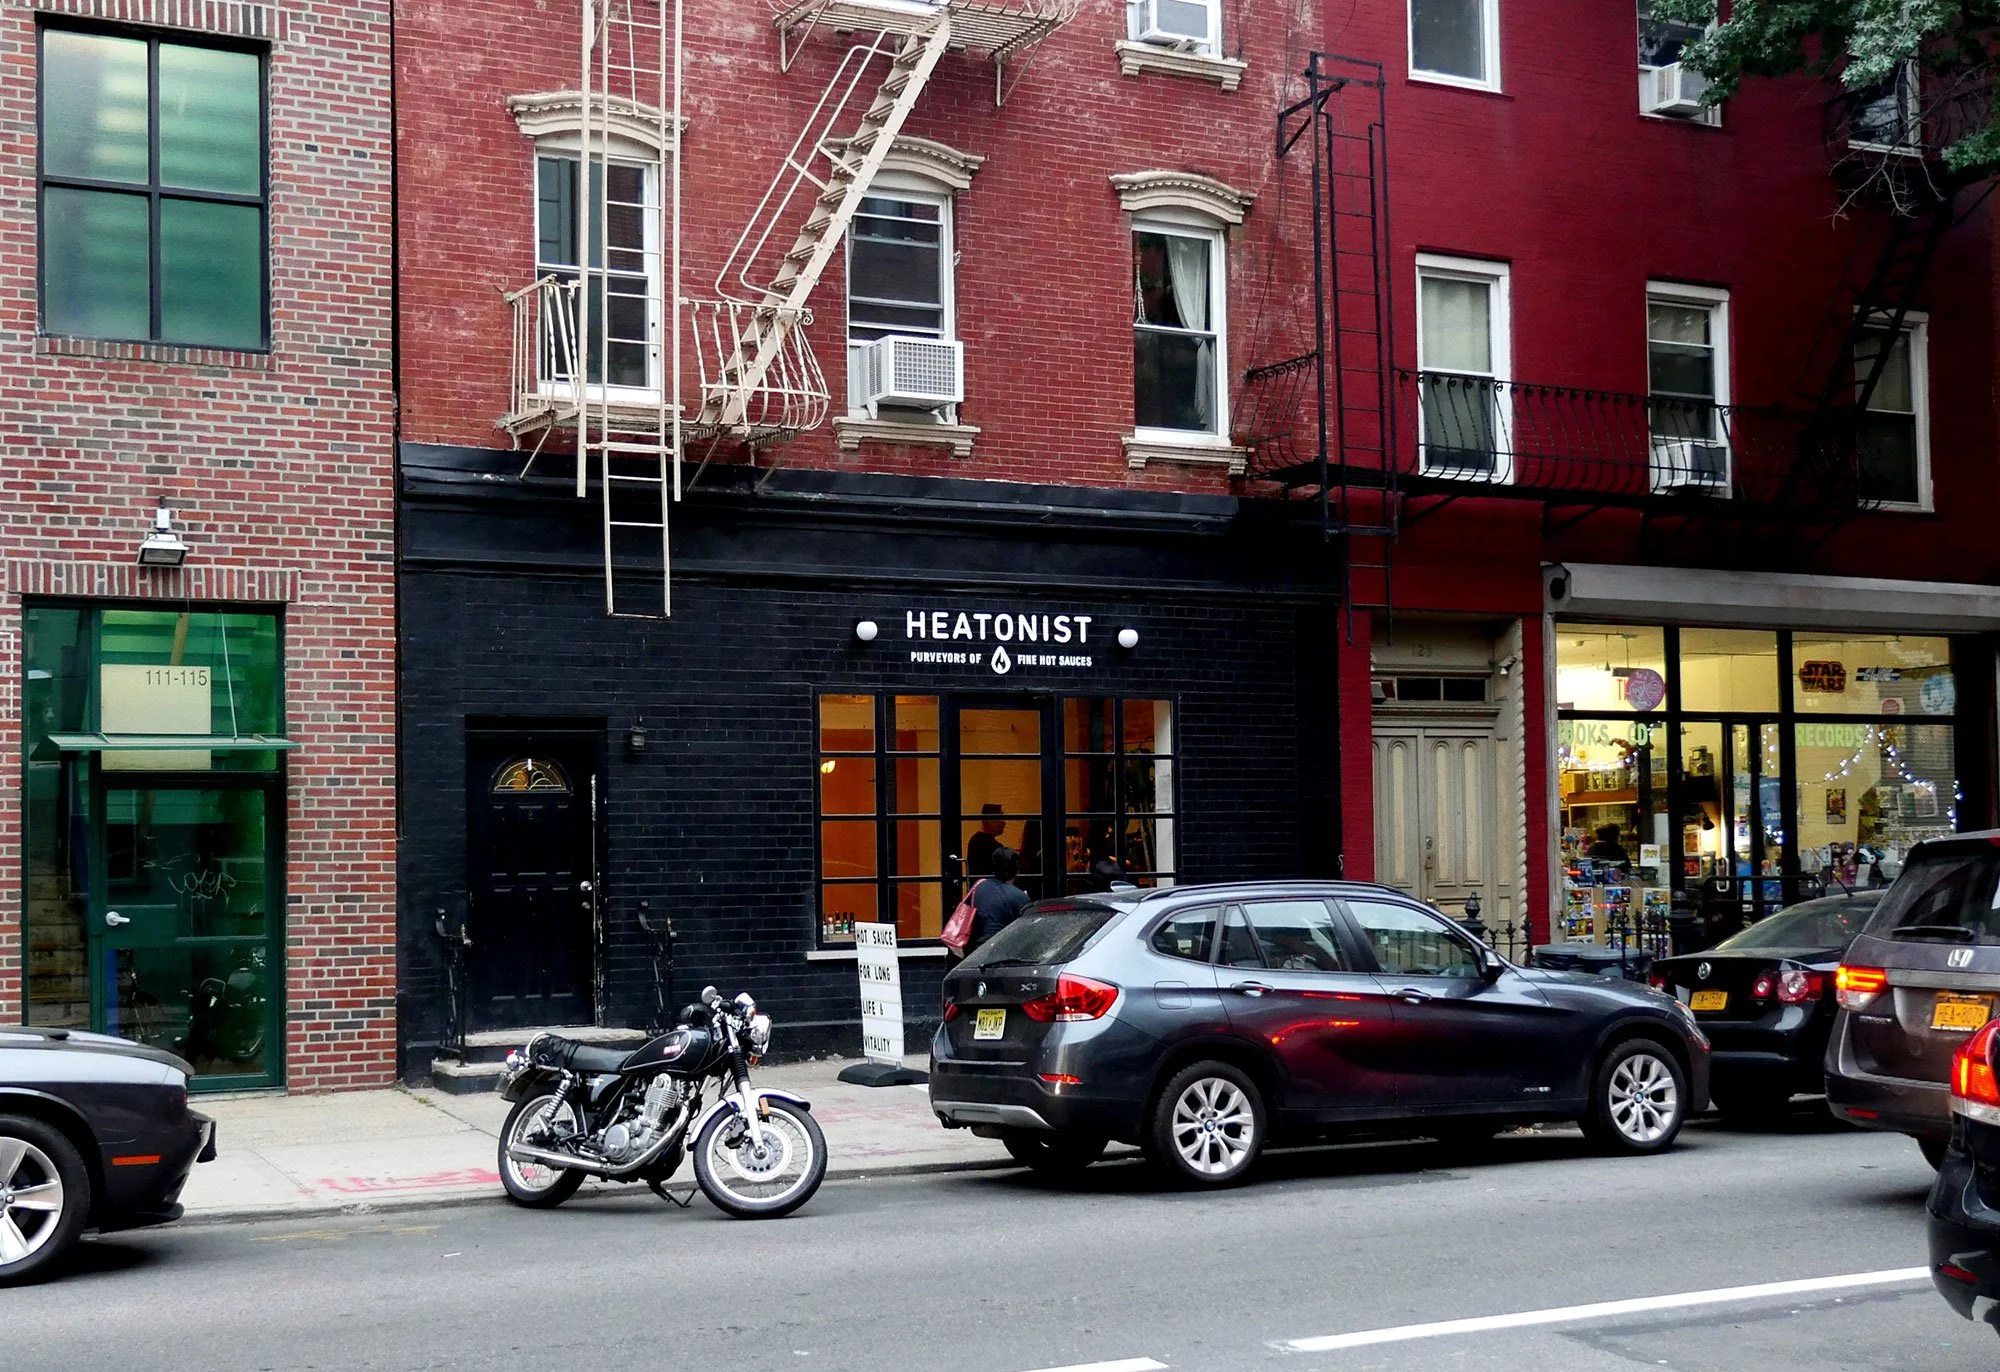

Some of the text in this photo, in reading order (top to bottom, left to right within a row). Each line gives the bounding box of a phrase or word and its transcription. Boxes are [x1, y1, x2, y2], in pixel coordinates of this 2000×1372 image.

[906, 610, 1092, 643] HEATONIST
[910, 651, 1092, 667] PURVEYORS OF FINE HOT SAUCES
[146, 669, 208, 686] 111-115
[1800, 662, 1845, 677] STAR
[1801, 676, 1844, 691] WARS
[1797, 724, 1864, 748] RECORDS
[872, 930, 893, 946] SAUCE
[859, 964, 891, 981] FOR LONG
[862, 1000, 876, 1015] LIFE
[864, 1036, 891, 1053] VITALITY
